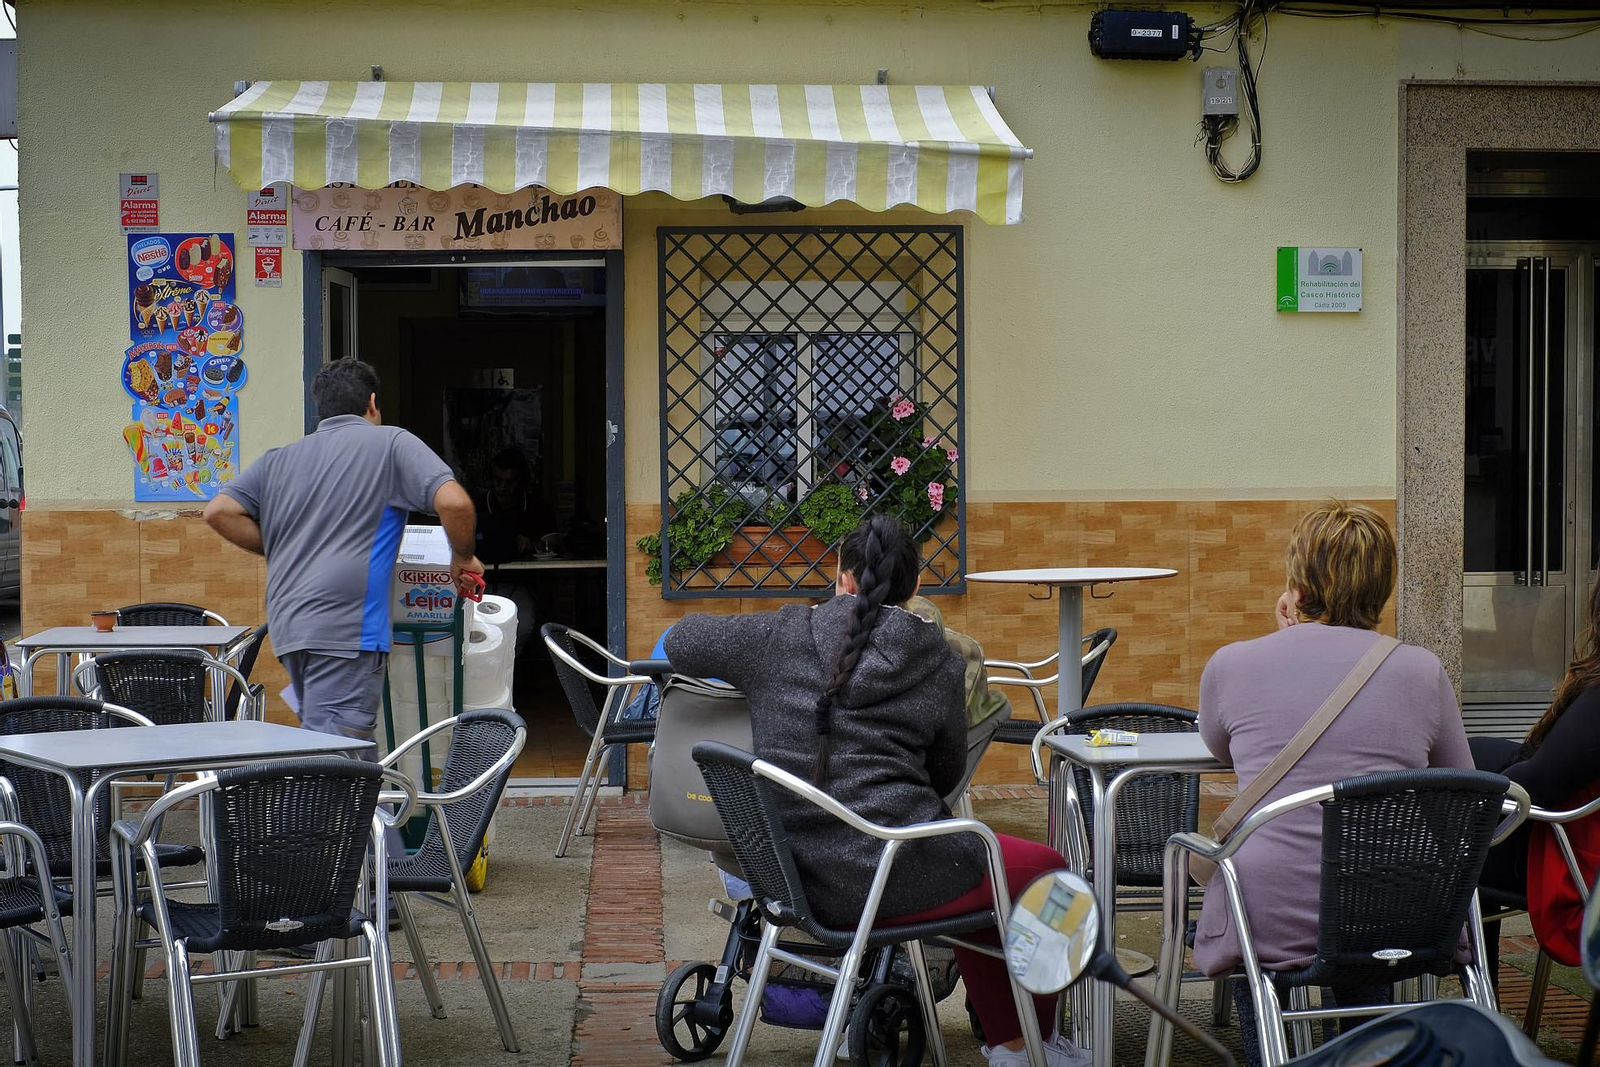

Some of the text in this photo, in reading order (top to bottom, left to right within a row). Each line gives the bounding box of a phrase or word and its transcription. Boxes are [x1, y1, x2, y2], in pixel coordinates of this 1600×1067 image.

[122, 201, 157, 209] Alarma
[248, 211, 286, 220] Alarma
[315, 212, 373, 231] CAFÉ
[392, 215, 436, 231] BAR
[452, 194, 597, 241] Manchao
[1300, 280, 1361, 288] Rehabilitación del
[207, 425, 216, 434] 1€
[405, 592, 453, 611] Lejía
[406, 611, 455, 619] AMARILLA
[686, 791, 713, 802] be coo
